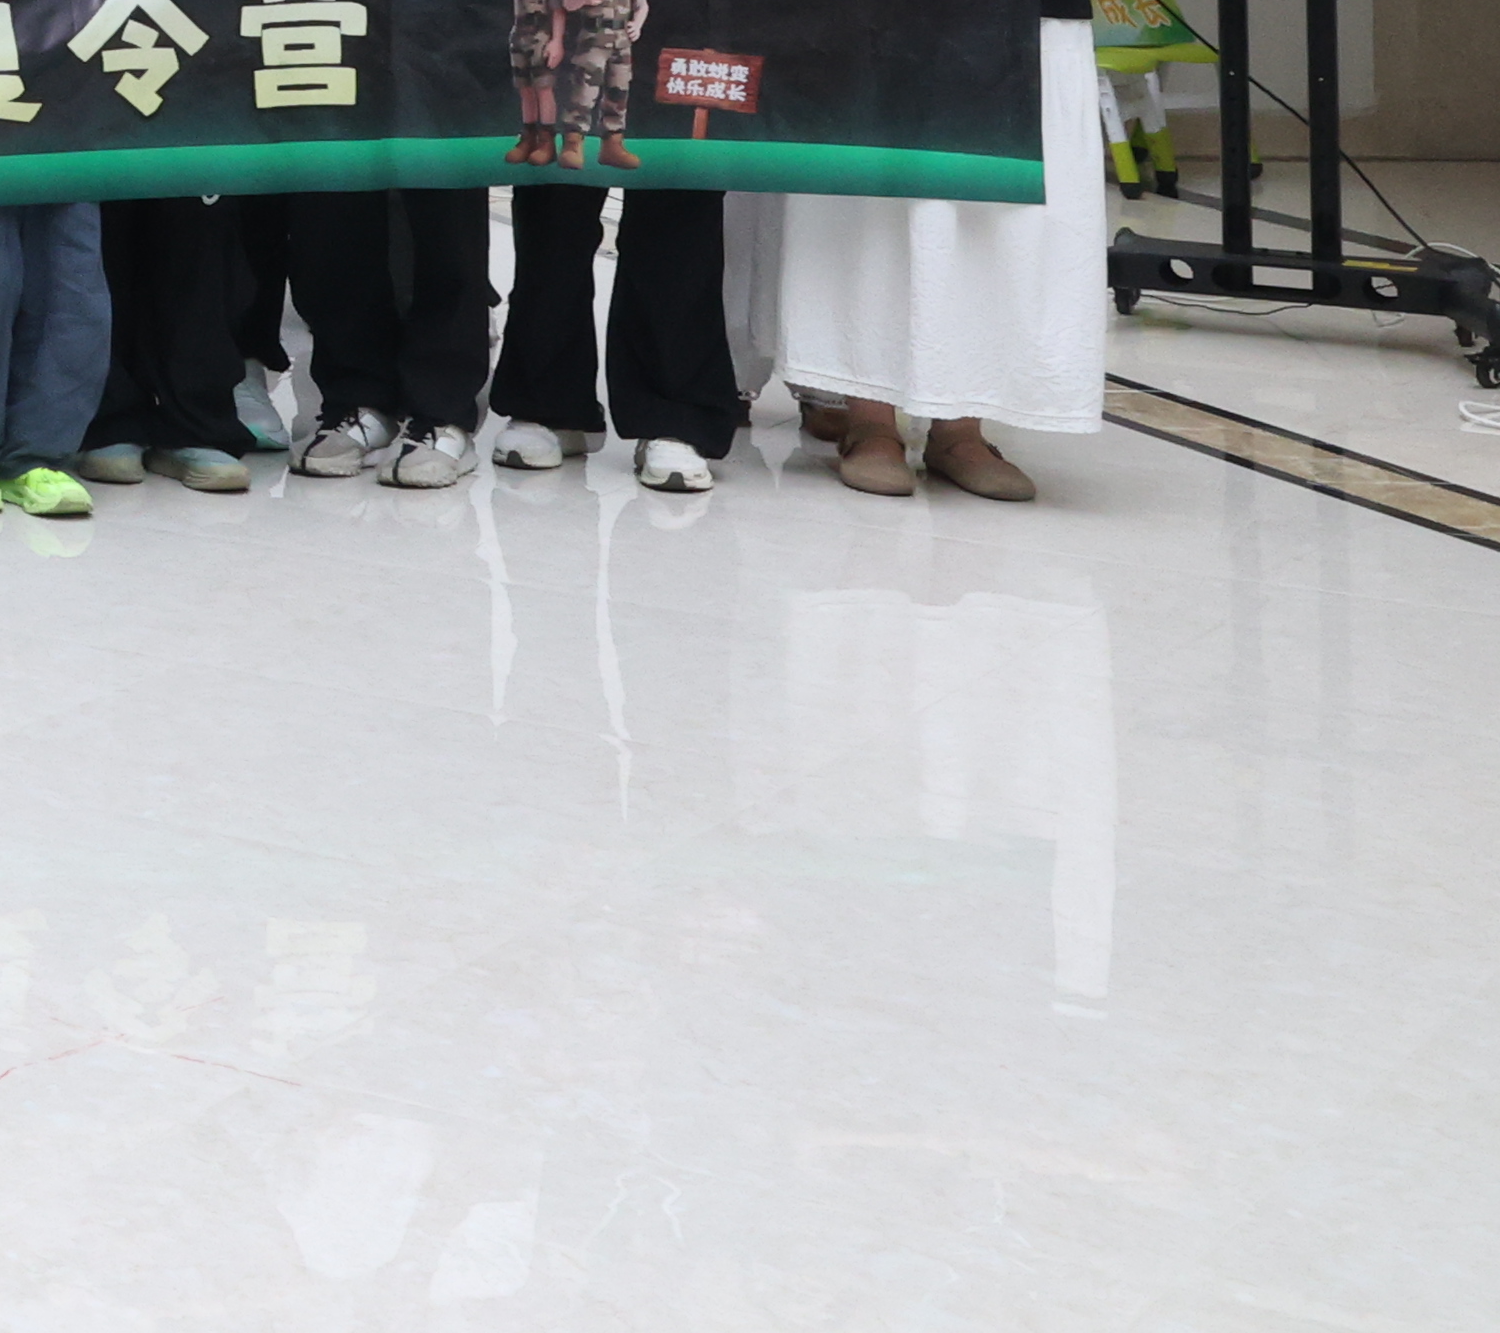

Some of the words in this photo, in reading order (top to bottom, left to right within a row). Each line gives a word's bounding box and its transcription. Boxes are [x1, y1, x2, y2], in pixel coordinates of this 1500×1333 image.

[670, 58, 749, 82] 勇敢蜕变
[666, 77, 747, 101] 快乐成长
